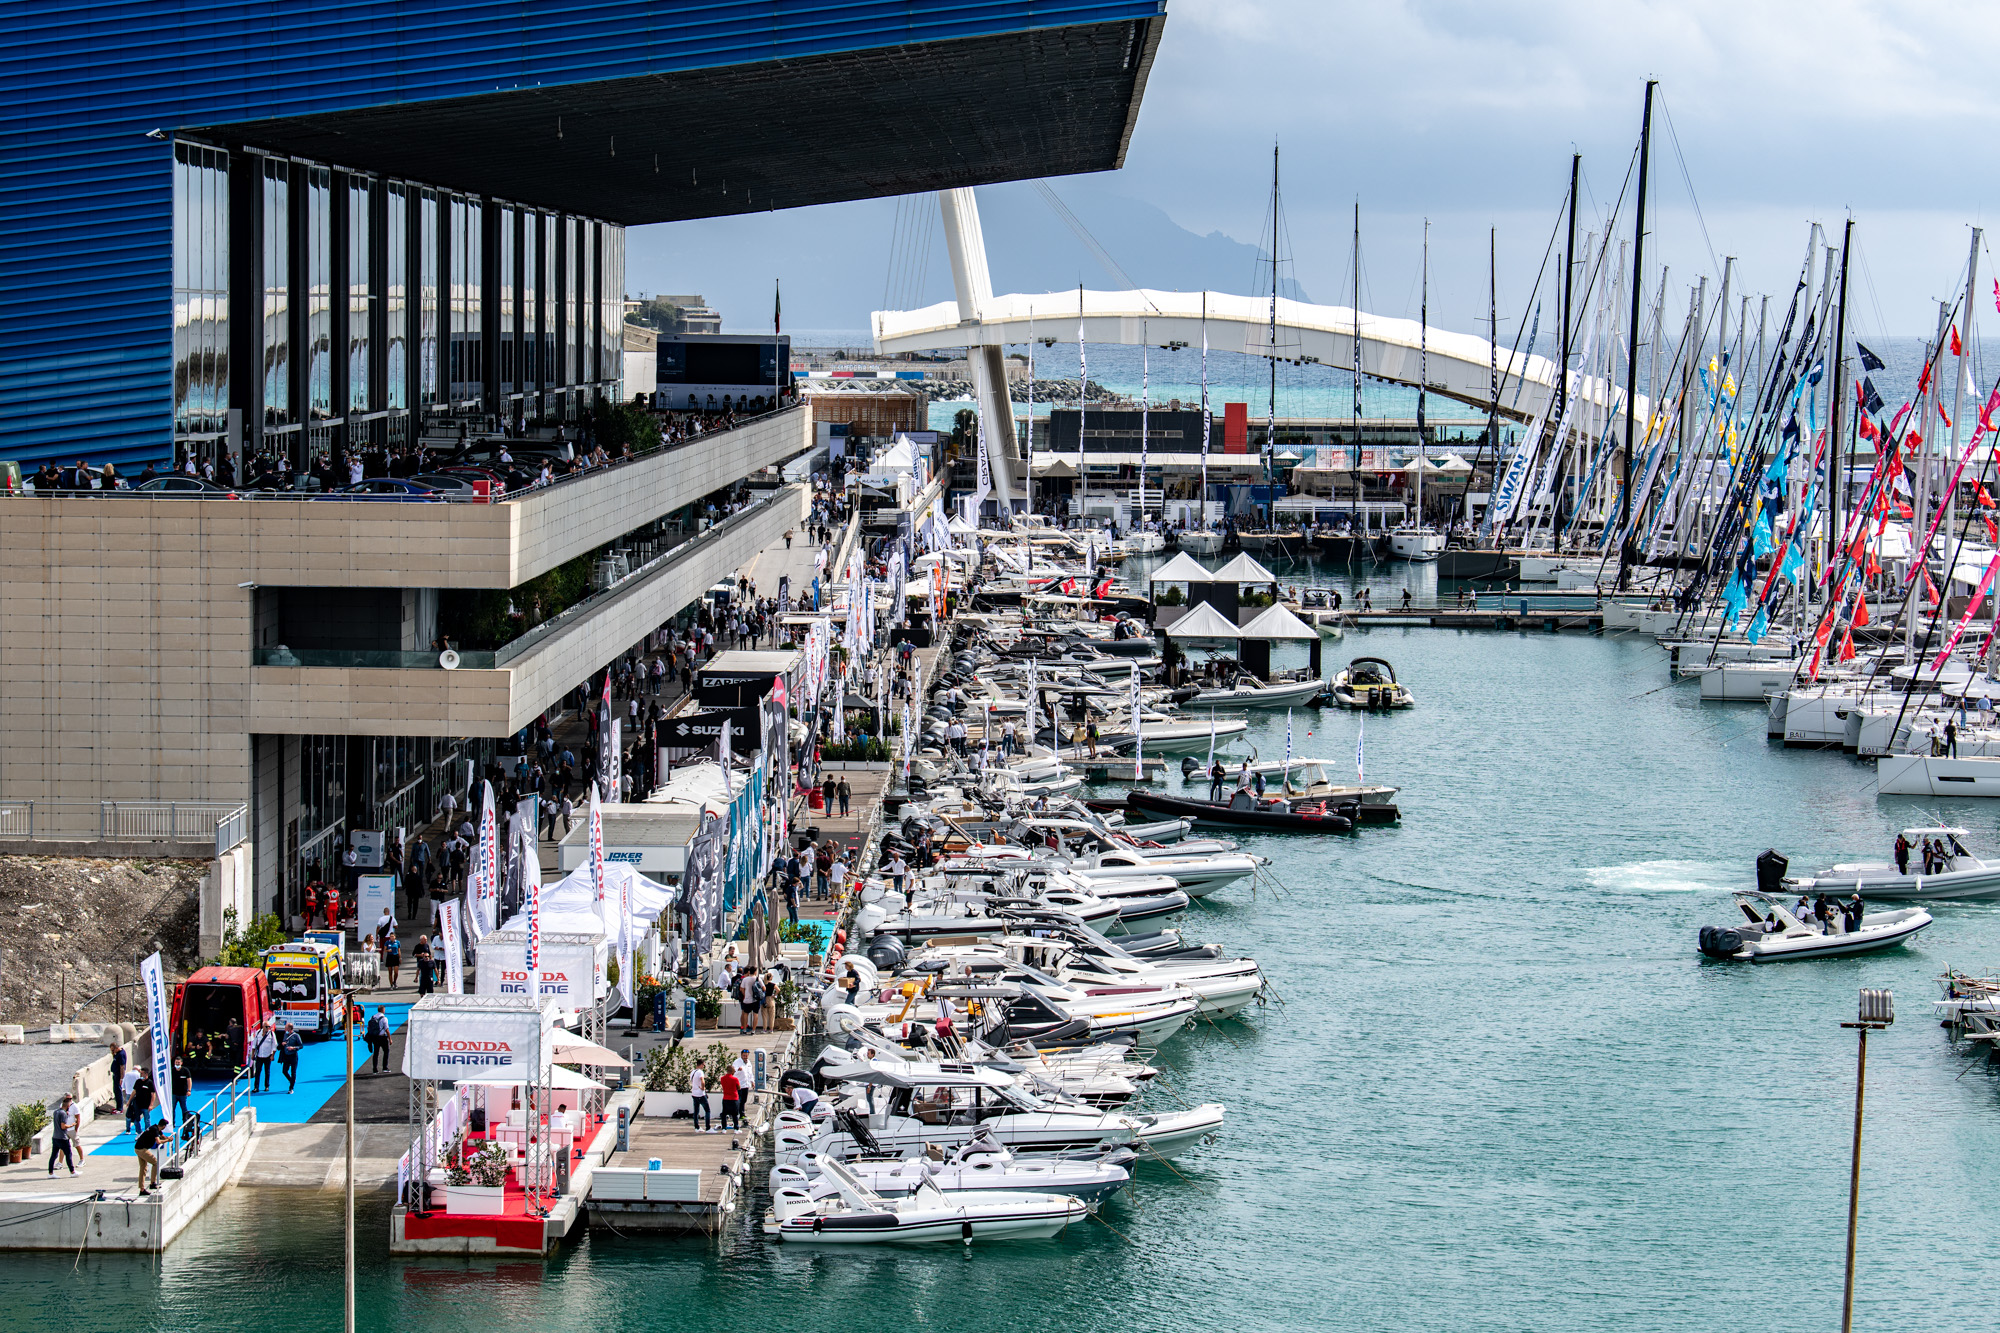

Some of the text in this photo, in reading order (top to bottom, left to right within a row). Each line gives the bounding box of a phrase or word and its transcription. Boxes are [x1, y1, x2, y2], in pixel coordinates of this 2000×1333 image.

[1495, 453, 1528, 514] SWAN
[691, 725, 745, 736] SUZKI
[604, 852, 643, 862] JOKER
[500, 985, 569, 994] MAINE
[438, 1040, 513, 1052] HONDA
